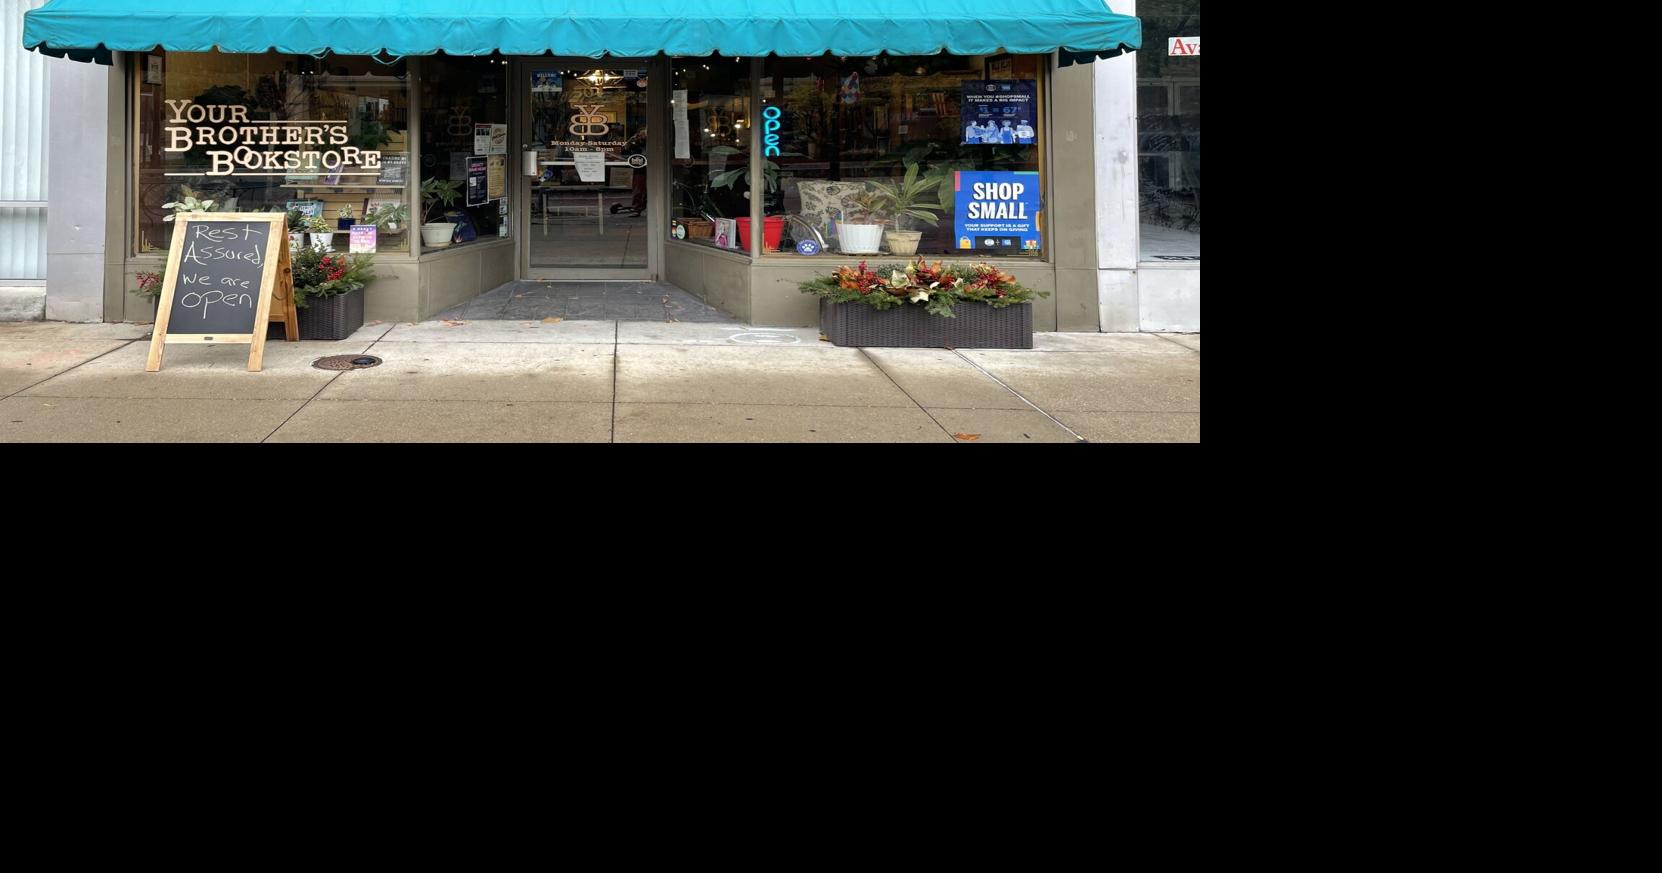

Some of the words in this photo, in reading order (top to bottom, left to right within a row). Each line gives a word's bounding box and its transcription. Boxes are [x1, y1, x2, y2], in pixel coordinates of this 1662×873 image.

[1170, 38, 1200, 55] Av
[165, 99, 250, 123] YOUR
[164, 124, 348, 152] BROTHER'S
[206, 145, 381, 176] BOOKSTORE
[973, 182, 1025, 200] SHOP
[967, 201, 1029, 220] SMALL
[192, 223, 263, 243] Rest
[184, 241, 264, 269] Assured,
[220, 276, 251, 289] are
